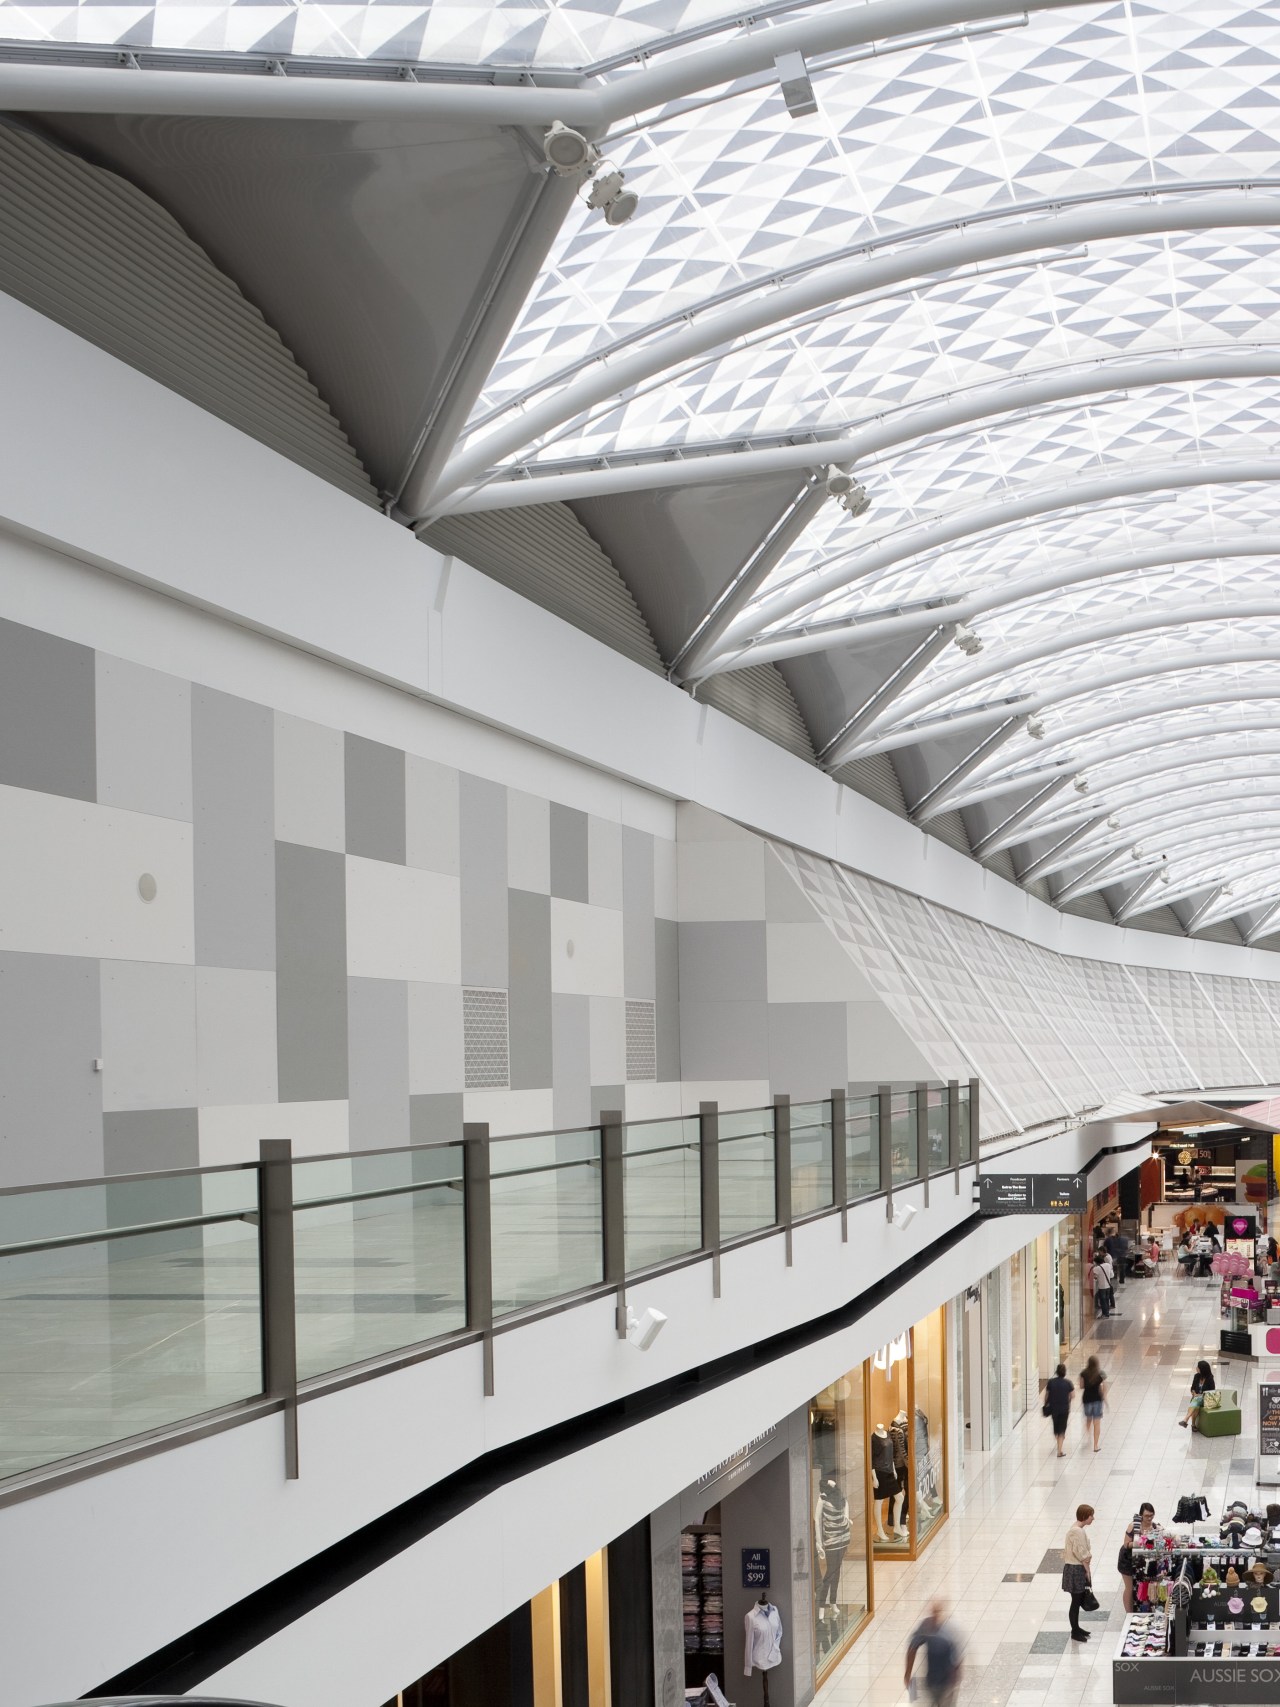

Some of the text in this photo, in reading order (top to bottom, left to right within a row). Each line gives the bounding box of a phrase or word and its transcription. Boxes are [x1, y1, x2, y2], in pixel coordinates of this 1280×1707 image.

[746, 1562, 766, 1570] Shirts
[1115, 1662, 1140, 1672] SOX
[1190, 1668, 1246, 1682] AUSSIE
